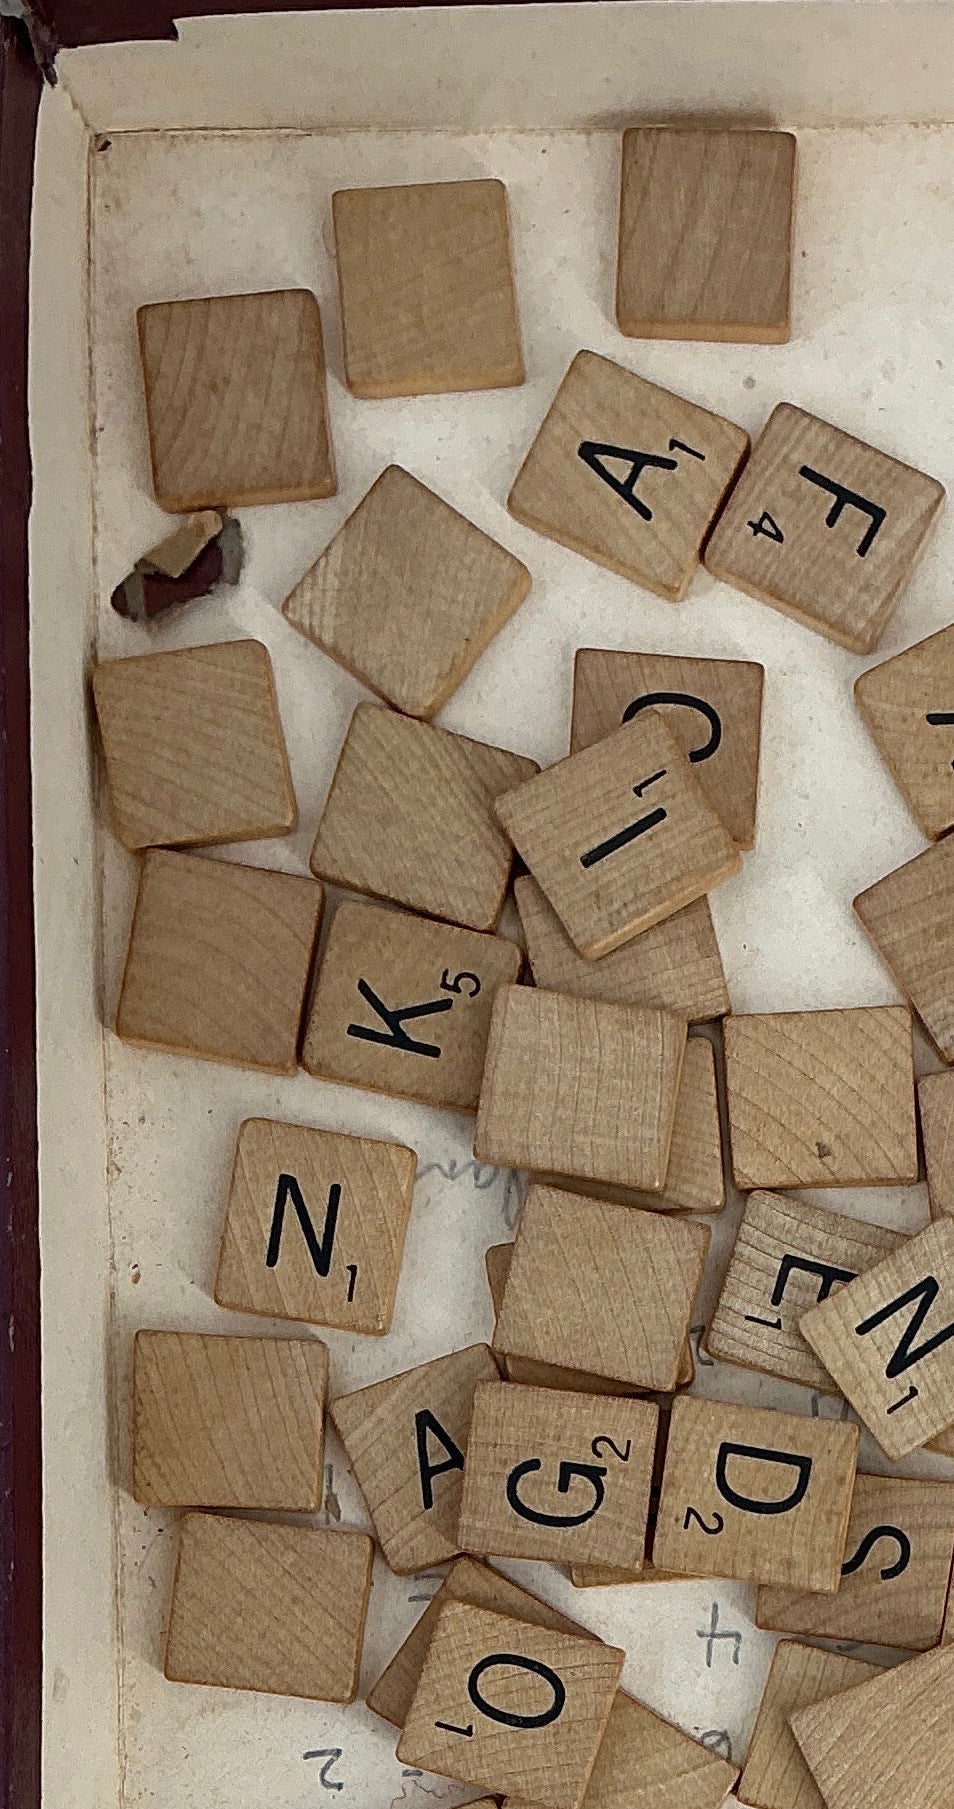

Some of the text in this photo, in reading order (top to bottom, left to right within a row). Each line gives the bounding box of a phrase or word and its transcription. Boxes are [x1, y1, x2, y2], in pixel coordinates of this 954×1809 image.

[576, 437, 707, 523] A 1
[745, 464, 888, 559] F 4
[578, 768, 669, 870] I 1
[345, 967, 483, 1060] K 5
[264, 1172, 359, 1304] N 1
[743, 1314, 783, 1332] 1
[885, 1384, 920, 1416] 1
[413, 1407, 466, 1512] A
[505, 1434, 633, 1529] G 2
[682, 1440, 814, 1536] D 2
[433, 1652, 567, 1739] O 1
